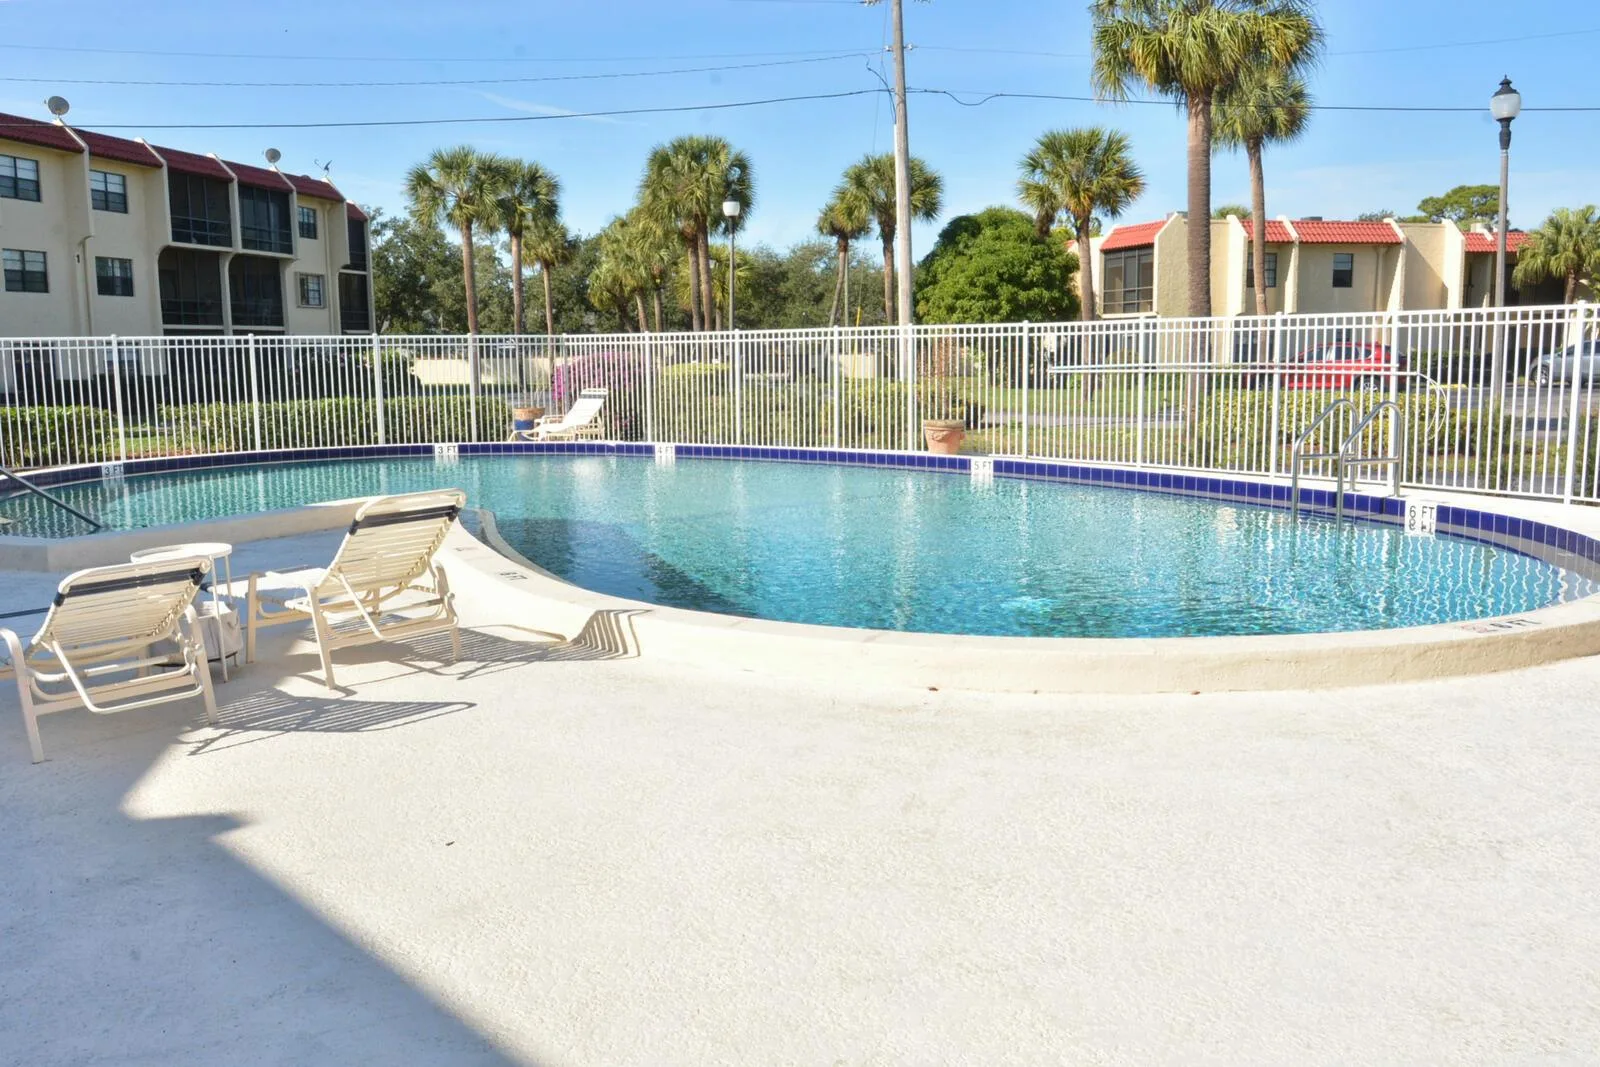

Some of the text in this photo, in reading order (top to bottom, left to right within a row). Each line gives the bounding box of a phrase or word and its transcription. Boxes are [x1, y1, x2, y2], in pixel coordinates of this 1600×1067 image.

[104, 464, 123, 475] 3 FT
[974, 460, 992, 470] 5 FT
[1409, 505, 1435, 520] 6 FT
